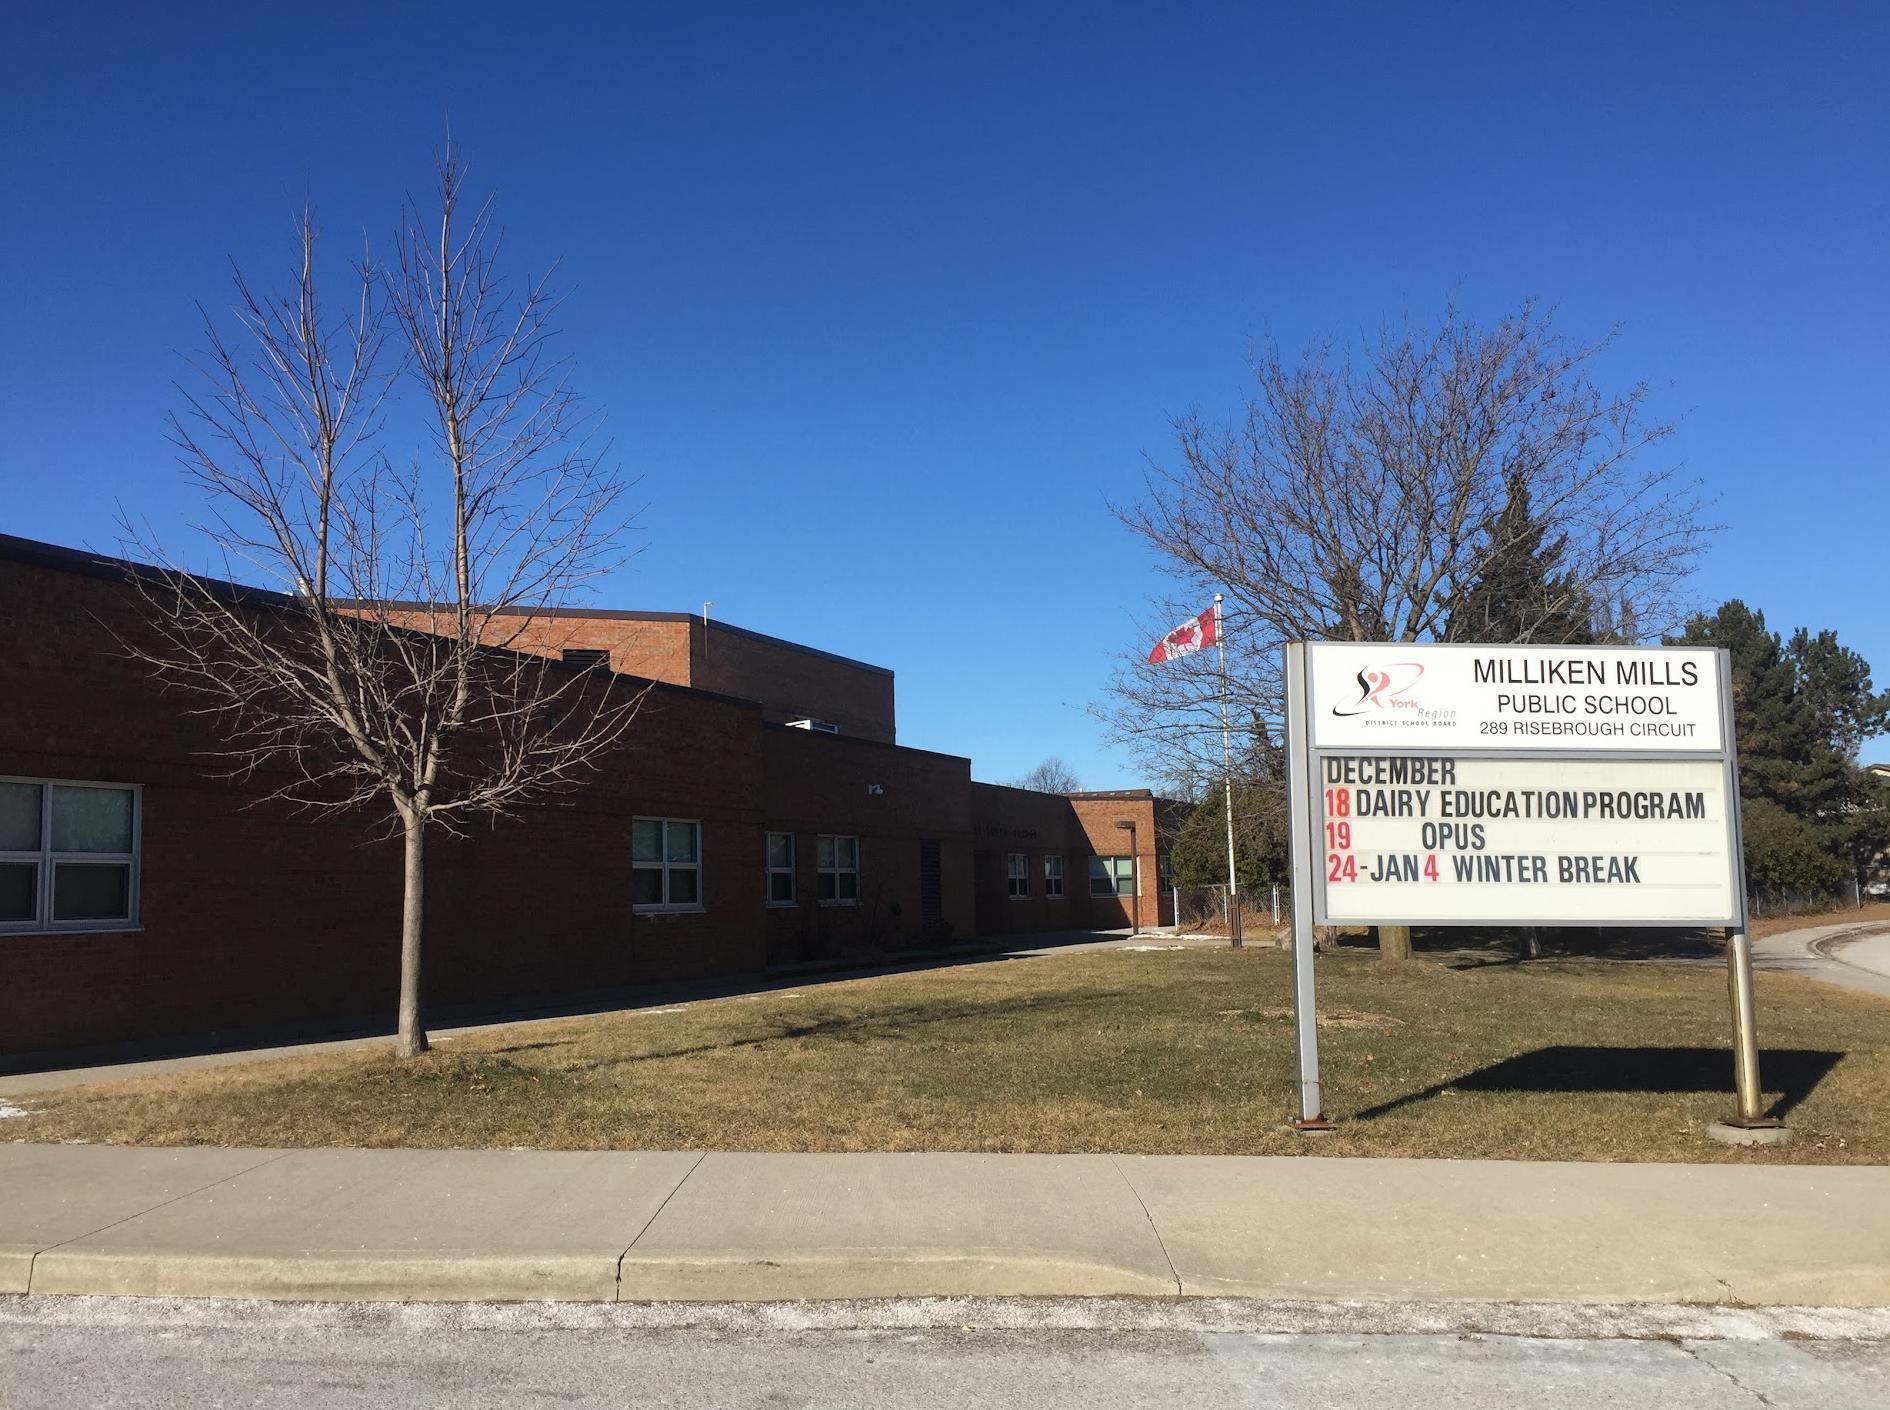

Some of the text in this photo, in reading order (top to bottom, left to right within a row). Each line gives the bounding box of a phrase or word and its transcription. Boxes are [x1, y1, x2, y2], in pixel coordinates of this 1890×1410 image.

[1474, 659, 1698, 686] MILLIKEN MILLS
[1389, 699, 1418, 708] York
[1417, 707, 1457, 720] Region
[1498, 694, 1678, 715] PUBLIC SCHOOL
[1480, 721, 1697, 737] 289 RISEBROUGH CIRCUIT
[1327, 758, 1456, 785] DECEMBER
[1325, 789, 1706, 819] 18 DAIRY EDUCATION PROGRAM
[1326, 821, 1486, 850] 19 OPUS
[1424, 854, 1439, 882] 4
[1452, 855, 1548, 883] WINTER
[1558, 856, 1641, 883] BREAK
